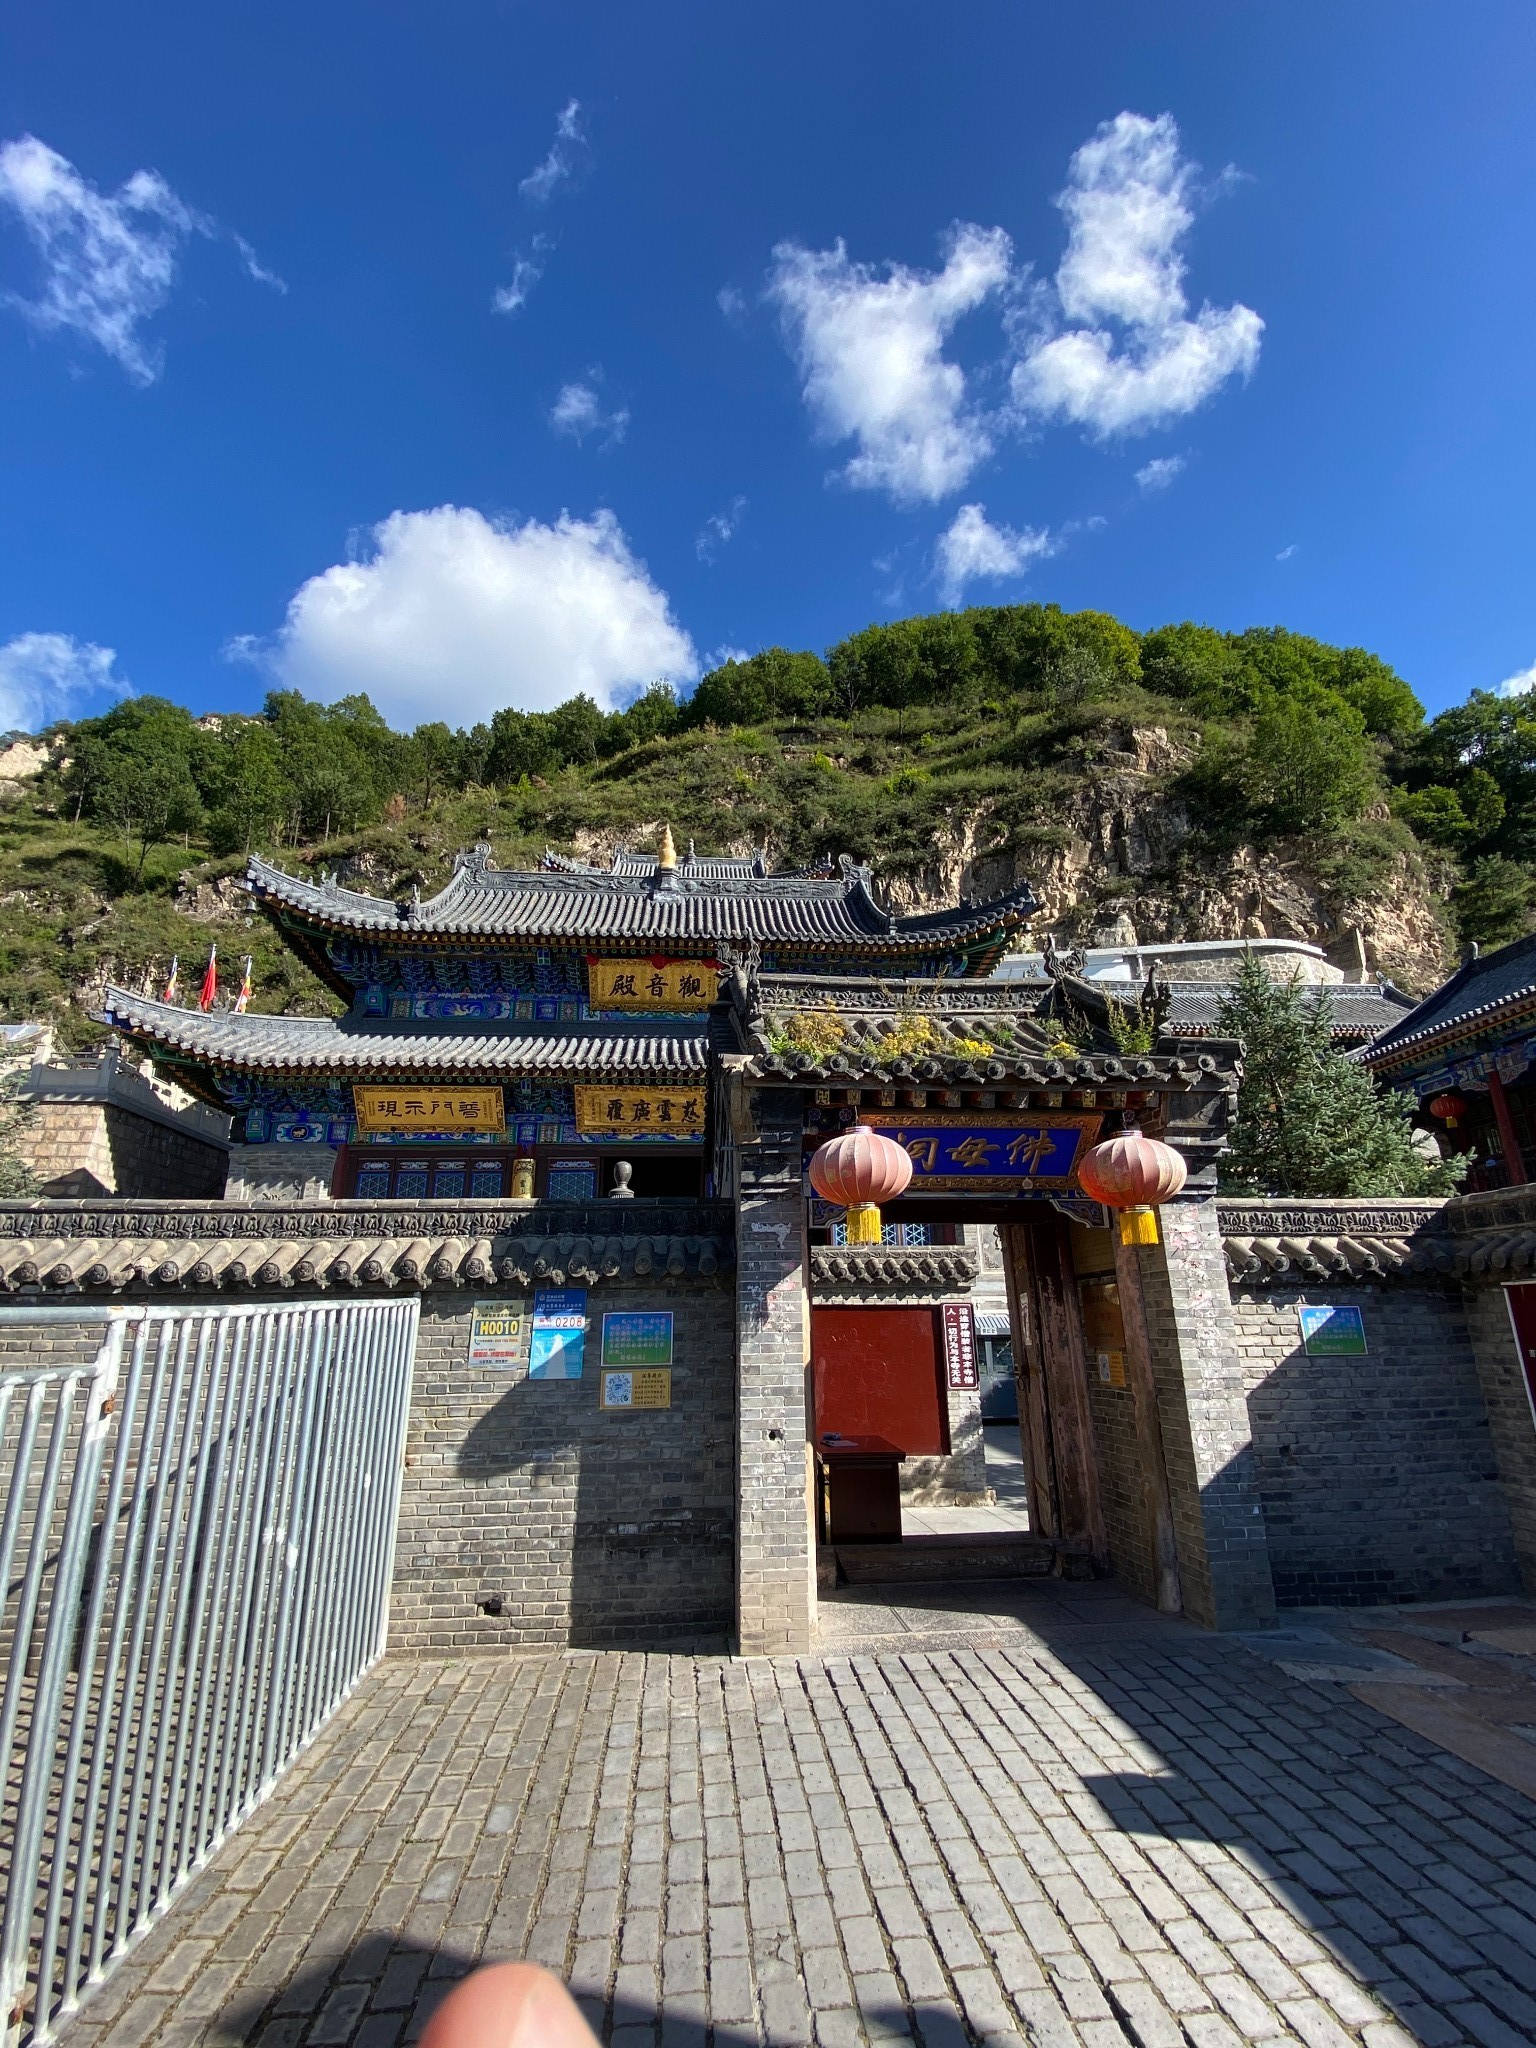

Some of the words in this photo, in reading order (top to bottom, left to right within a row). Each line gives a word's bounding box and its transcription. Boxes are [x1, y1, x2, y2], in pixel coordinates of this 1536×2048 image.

[608, 973, 707, 998] 觀音殿
[480, 1320, 518, 1335] H0010
[555, 1317, 583, 1328] 0208
